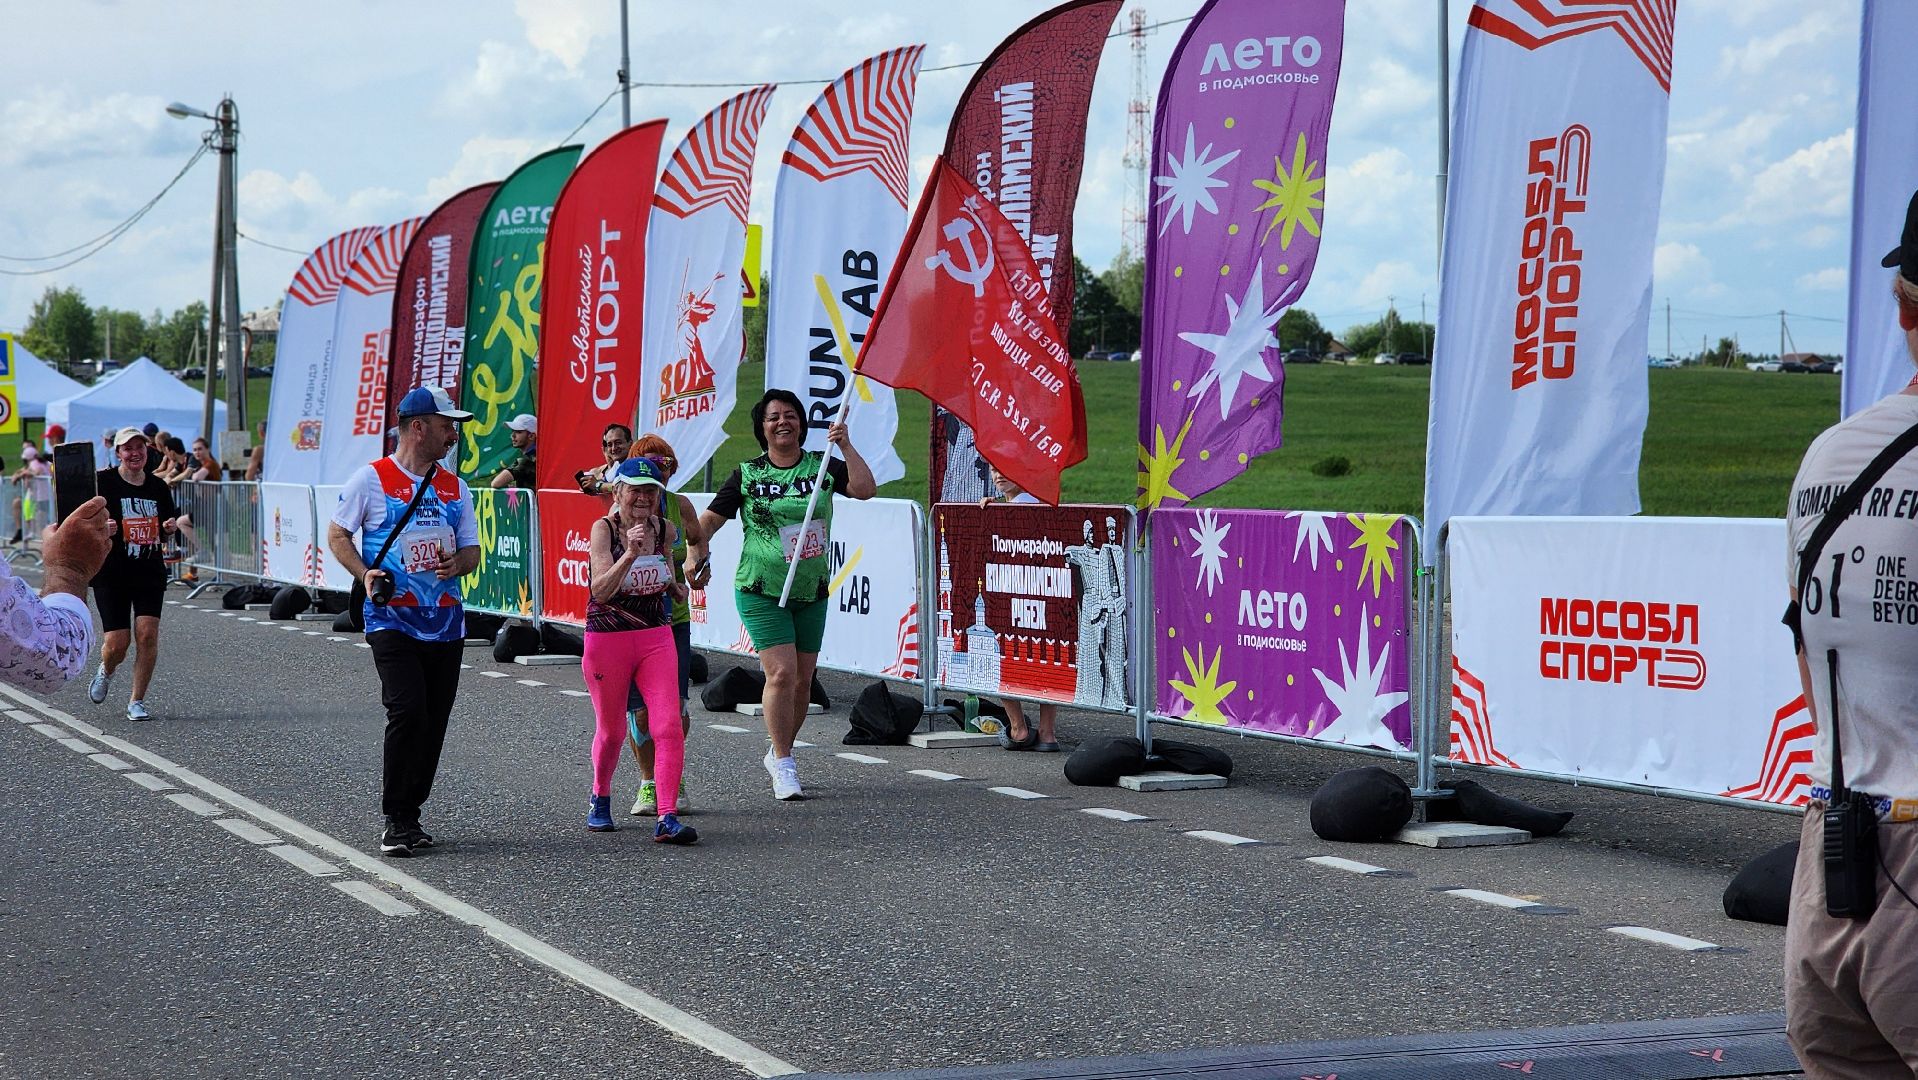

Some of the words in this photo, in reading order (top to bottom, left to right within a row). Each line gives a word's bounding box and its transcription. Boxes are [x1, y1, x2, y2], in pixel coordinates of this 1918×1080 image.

[1009, 269, 1041, 300] 150
[1512, 137, 1557, 390] МОСОБЛ
[1542, 187, 1586, 379] СПОРТ
[570, 243, 592, 383] Советский
[592, 219, 621, 410] СПОРТ
[302, 363, 317, 417] Команда
[352, 333, 378, 436] МОСОБЛ
[367, 354, 389, 435] СПОРТ
[808, 327, 846, 430] RUN
[1797, 485, 1861, 519] КОМАНА
[1867, 488, 1893, 517] RR
[130, 527, 151, 540] 5147
[992, 535, 1063, 559] Полумарафон
[631, 569, 660, 587] 3122
[986, 563, 1072, 598] ВОЛОКОЛАМСКИЙ
[1876, 556, 1906, 578] ONE
[840, 575, 870, 615] LAB
[1011, 598, 1046, 630] РУБЕЖ
[1541, 598, 1698, 645] МОСОБЛ
[1540, 641, 1662, 687] СПОРТ
